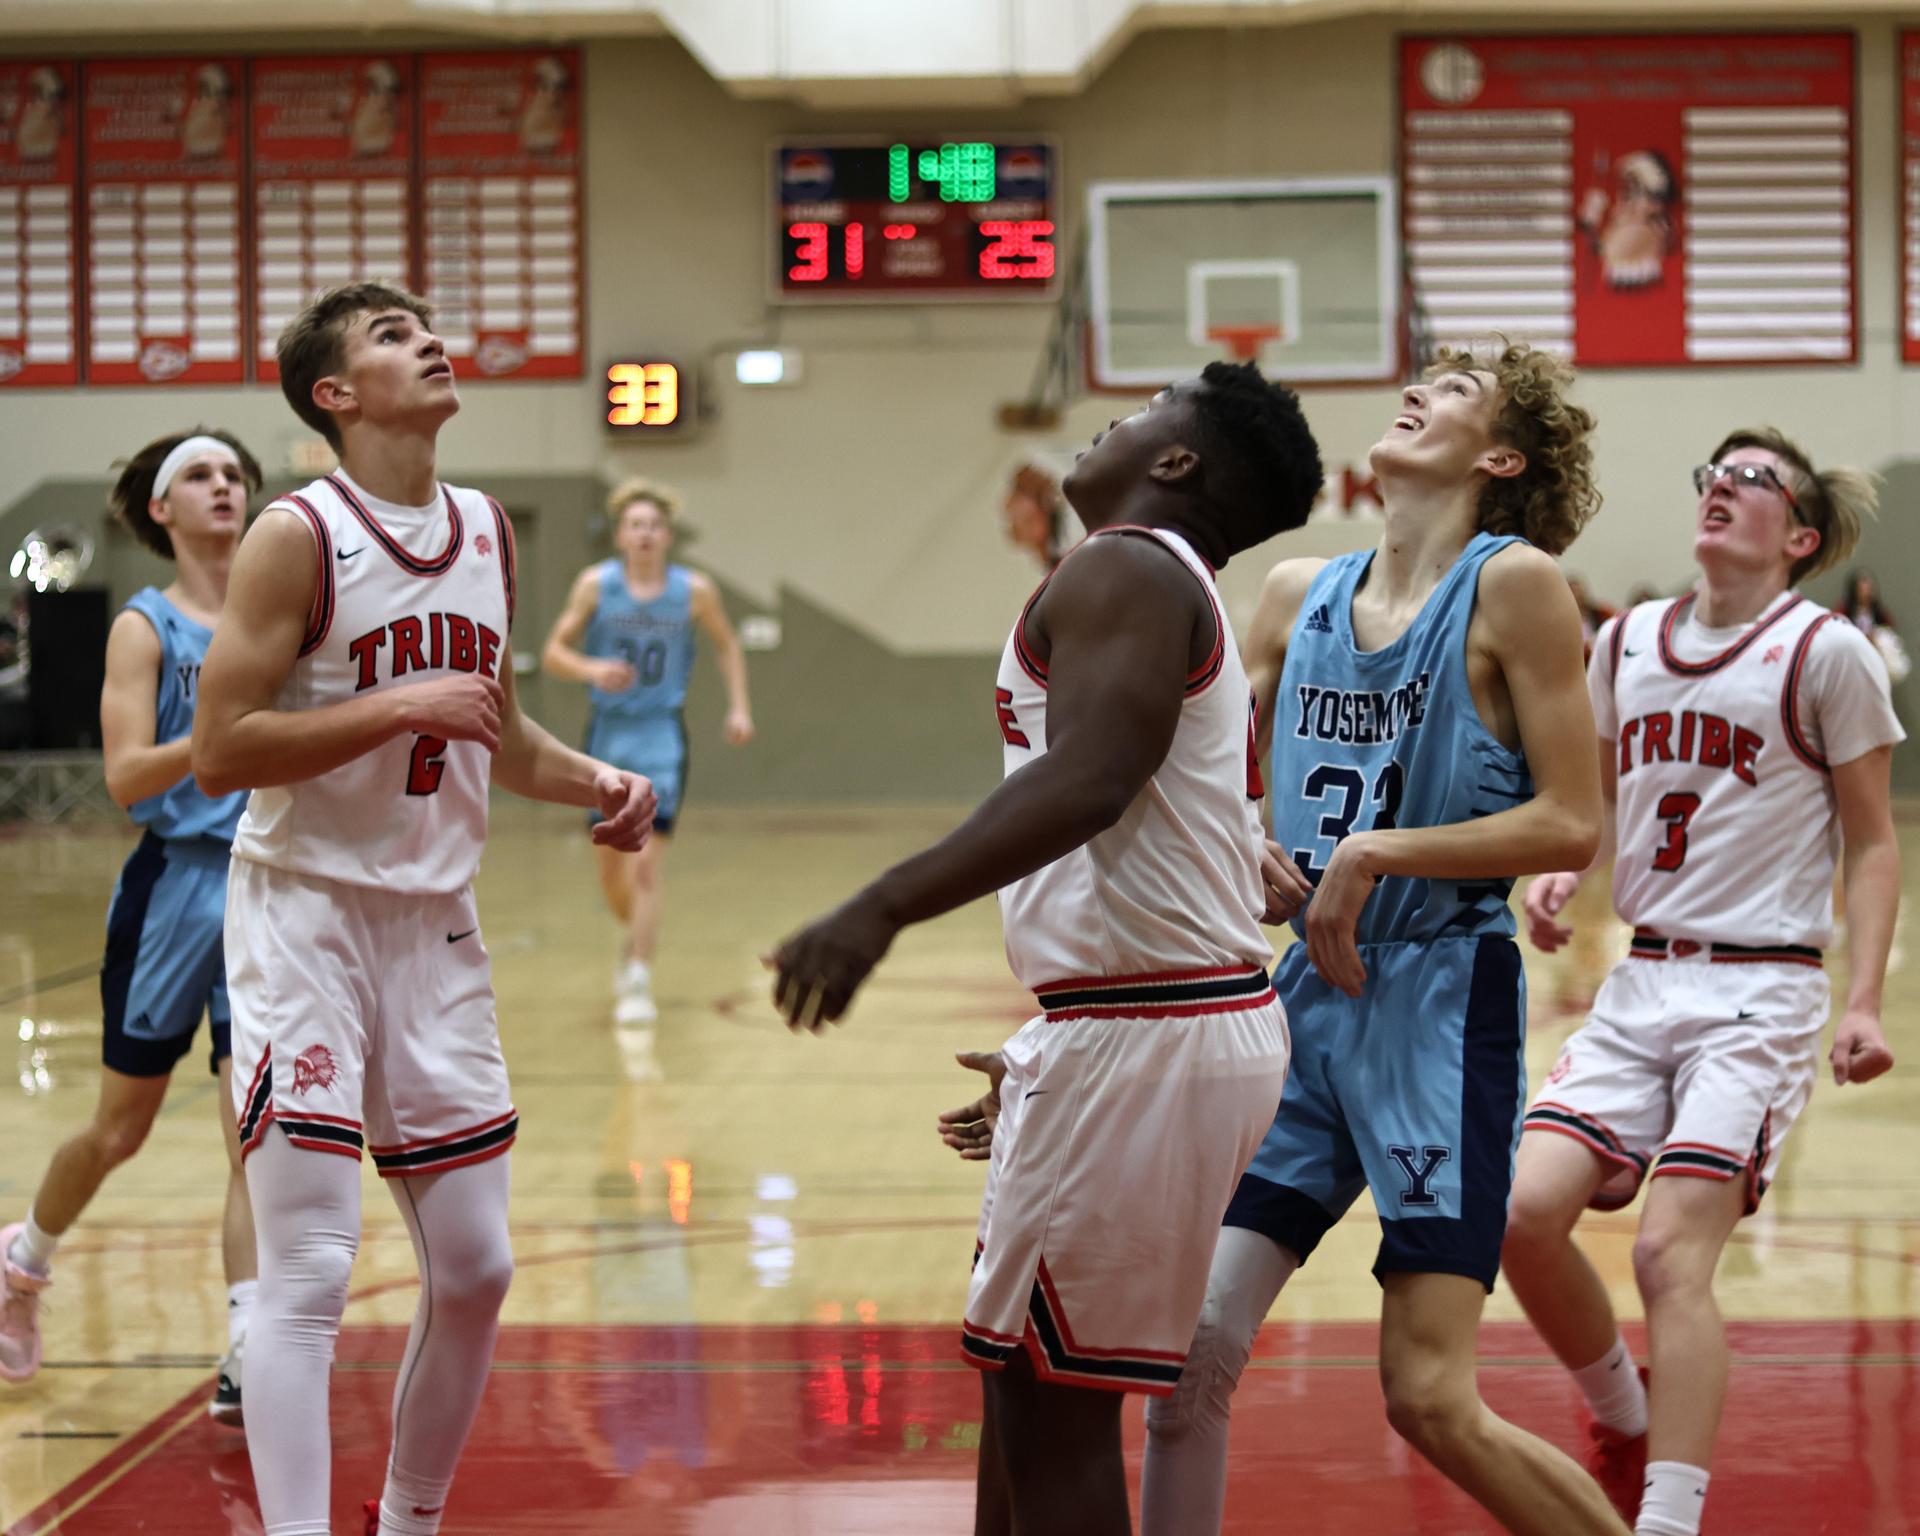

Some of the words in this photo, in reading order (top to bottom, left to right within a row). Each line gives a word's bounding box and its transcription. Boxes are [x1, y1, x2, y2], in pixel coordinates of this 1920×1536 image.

[788, 221, 865, 282] 31
[979, 220, 1055, 280] 25
[607, 362, 679, 426] 33
[349, 612, 501, 692] TRIBE
[405, 731, 449, 797] 2
[1618, 709, 1765, 789] TRIBE
[1651, 792, 1702, 872] 3
[1387, 1144, 1452, 1206] Y
